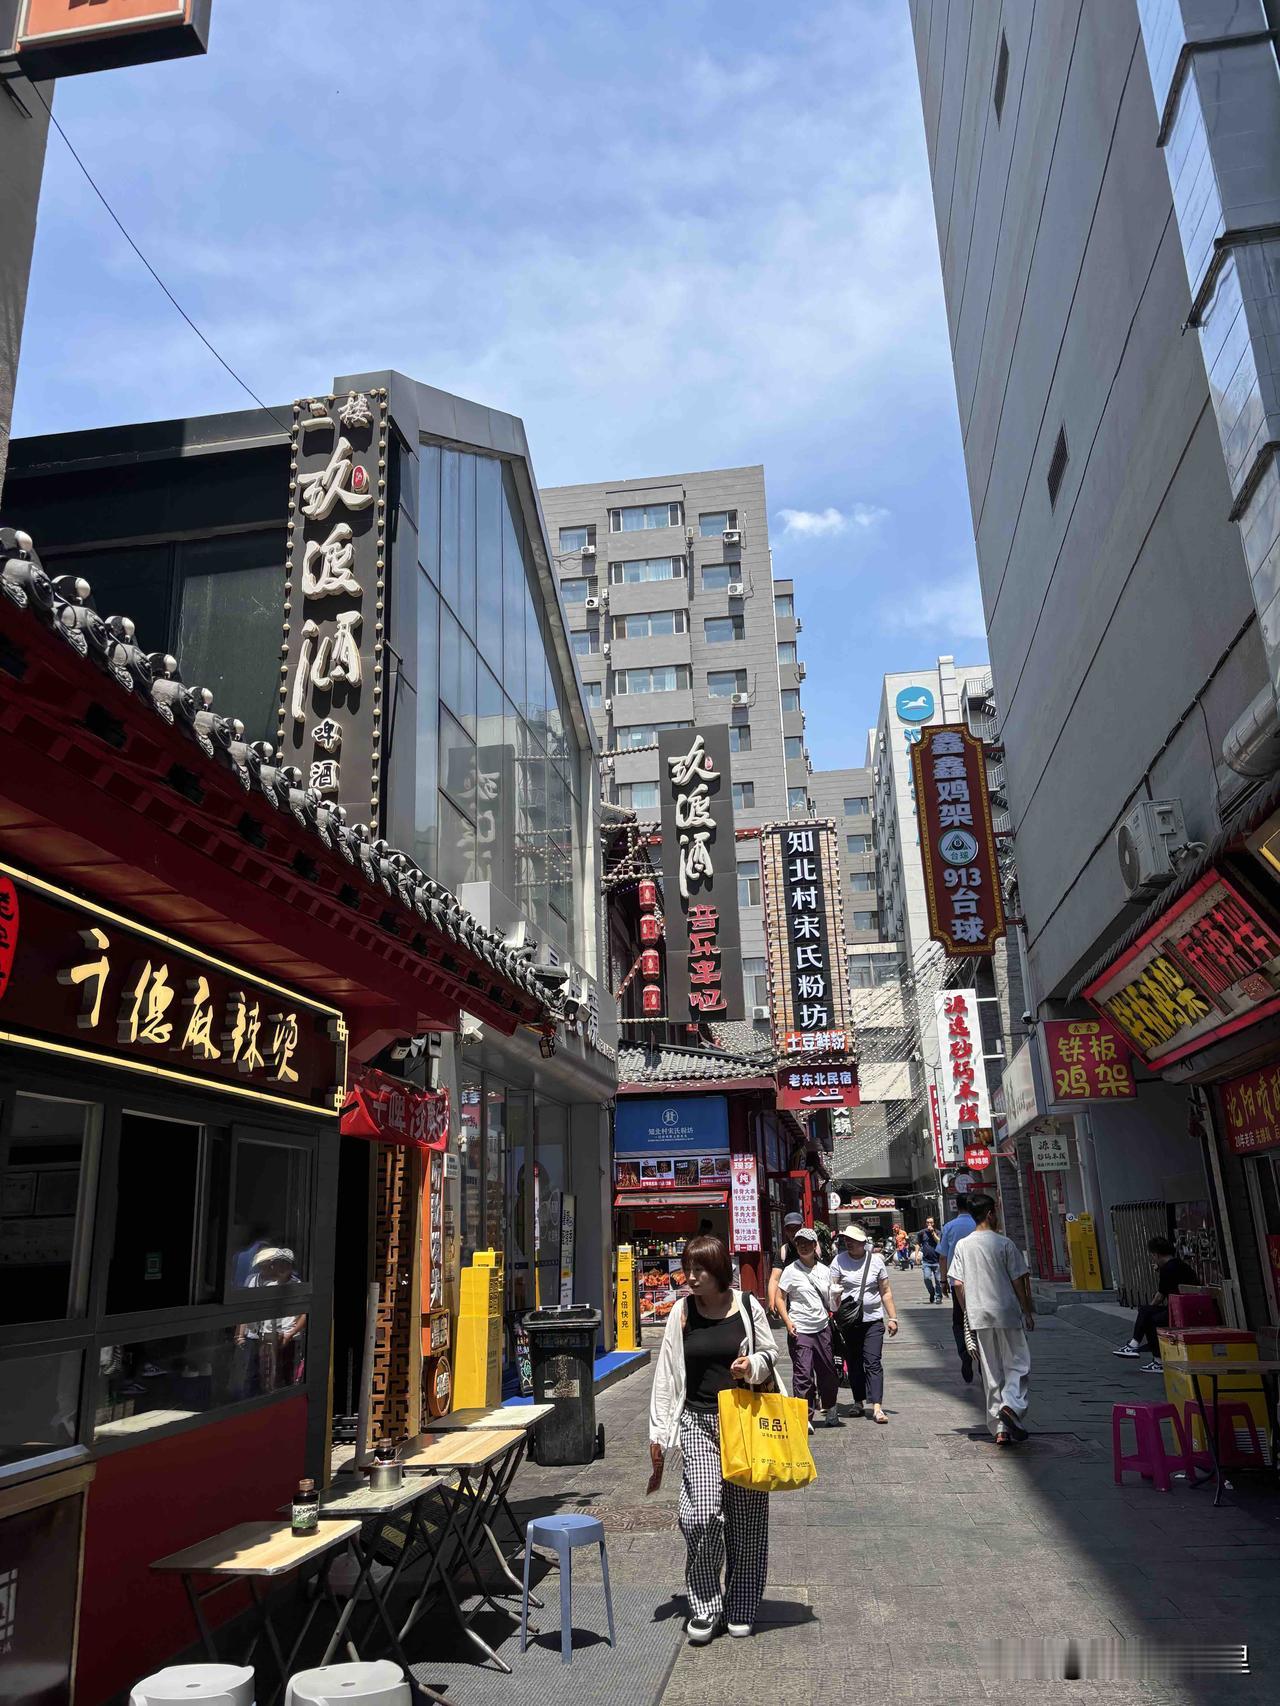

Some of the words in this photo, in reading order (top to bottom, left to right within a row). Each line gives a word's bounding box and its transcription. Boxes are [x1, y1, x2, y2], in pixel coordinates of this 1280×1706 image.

[301, 394, 374, 432] 二楼
[309, 717, 343, 792] 啤酒
[931, 732, 974, 827] 鑫鑫鸡架
[951, 851, 969, 860] 台球
[944, 868, 982, 888] 913
[787, 831, 828, 1029] 知北村宋氏粉坊
[951, 887, 986, 943] 台球
[686, 904, 728, 1011] 音乐串吧
[1105, 957, 1211, 1048] 铁板鸡架
[787, 1031, 846, 1052] 土豆鲜粉
[1057, 1034, 1118, 1063] 铁板
[788, 1071, 852, 1088] 老东北民宿
[816, 1088, 840, 1096] 入口
[1055, 1063, 1130, 1097] 鸡架
[620, 1291, 630, 1328] 5倍快充
